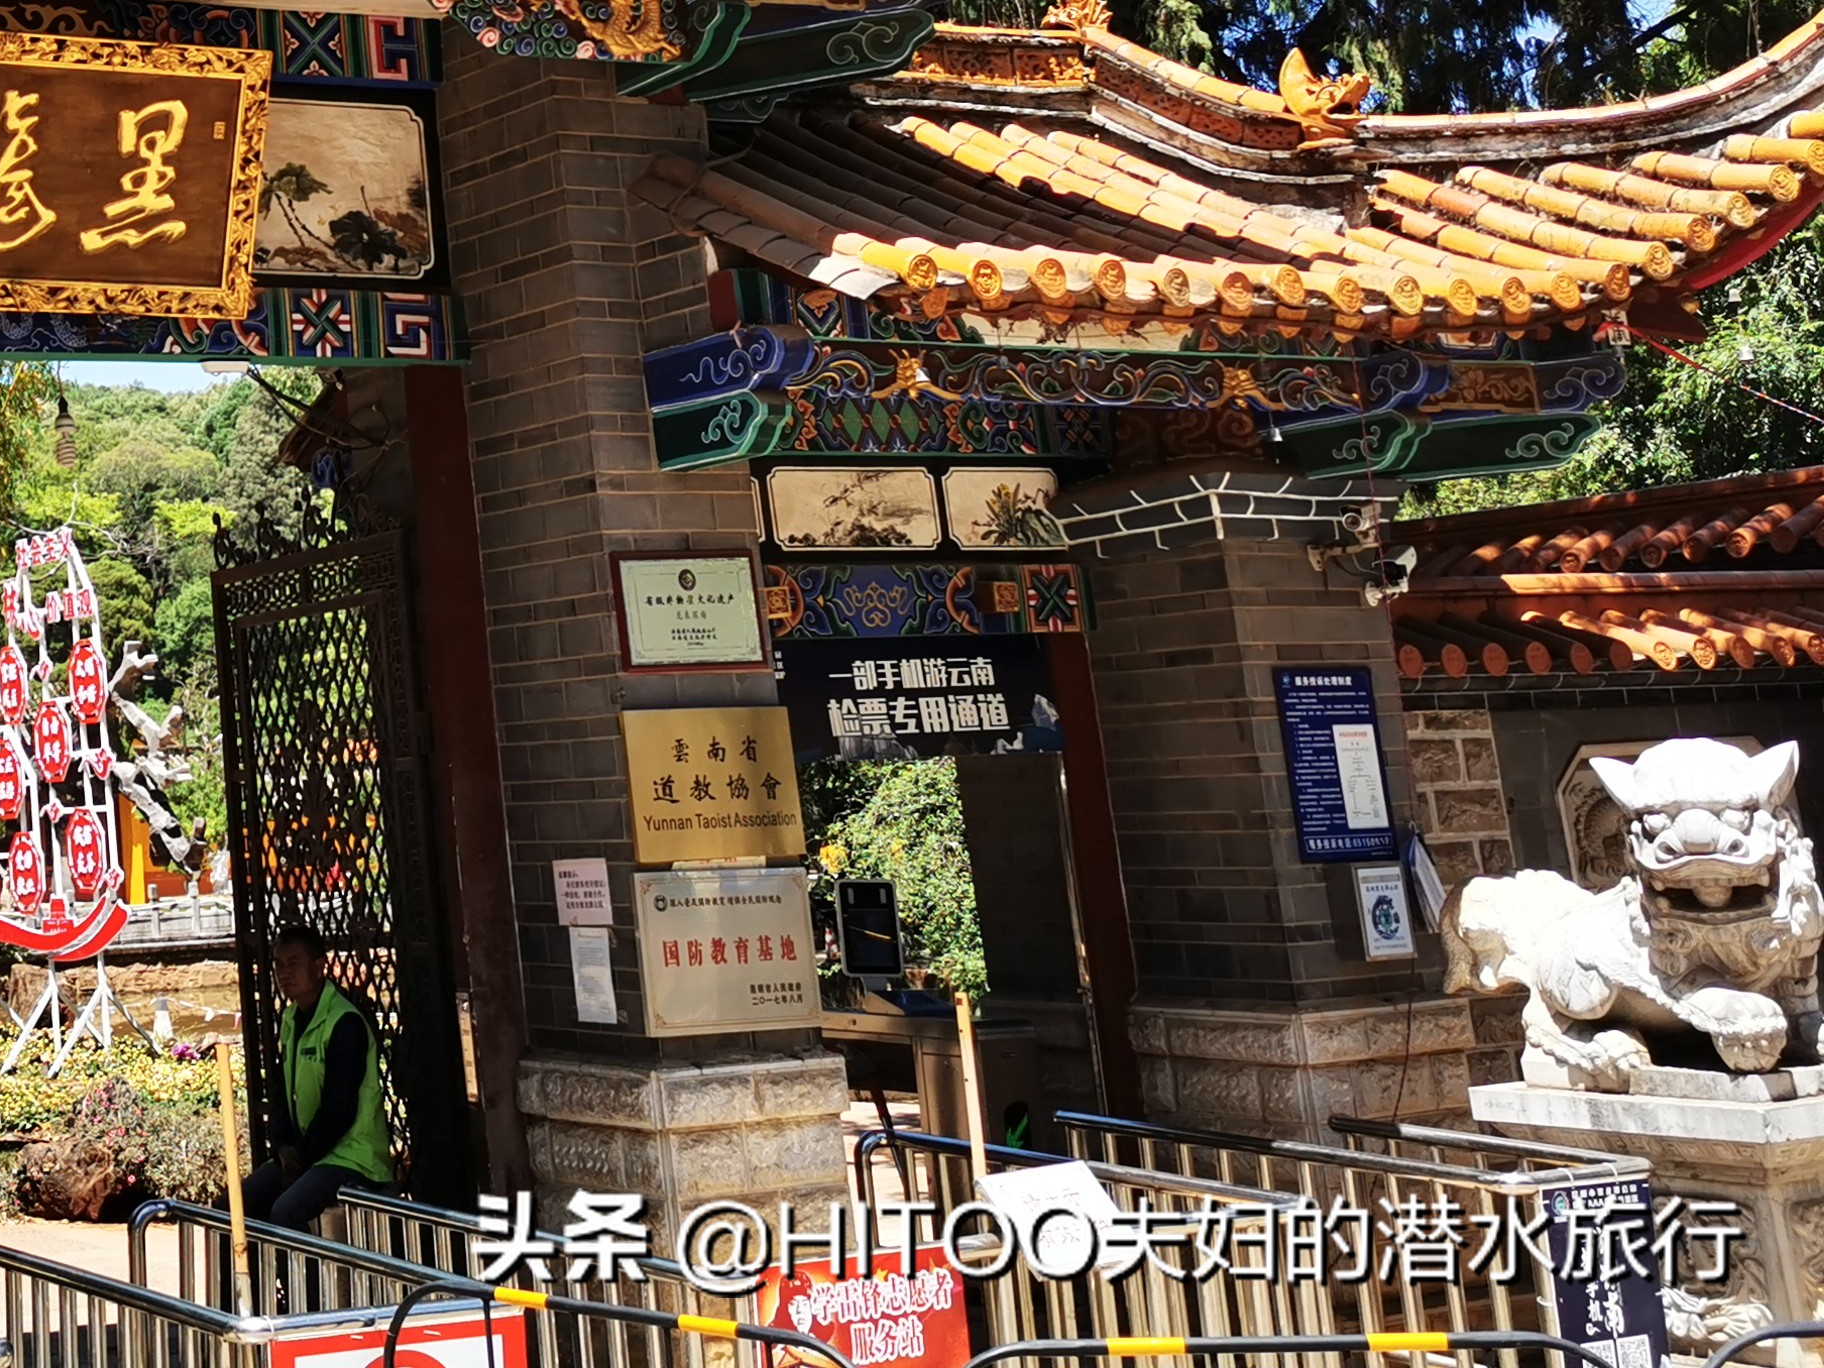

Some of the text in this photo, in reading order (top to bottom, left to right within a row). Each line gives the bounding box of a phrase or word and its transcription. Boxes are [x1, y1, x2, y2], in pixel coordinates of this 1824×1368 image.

[828, 656, 995, 691] 一部手机游云南
[827, 693, 1010, 737] 检票专用通道
[672, 735, 758, 763] 雲南省
[653, 772, 782, 804] 道教協會
[643, 810, 797, 832] Yunnan Taoist Association
[662, 934, 798, 968] 国防教育基地
[810, 1269, 953, 1326] 学雷锋志愿者
[851, 1317, 924, 1365] 服务站
